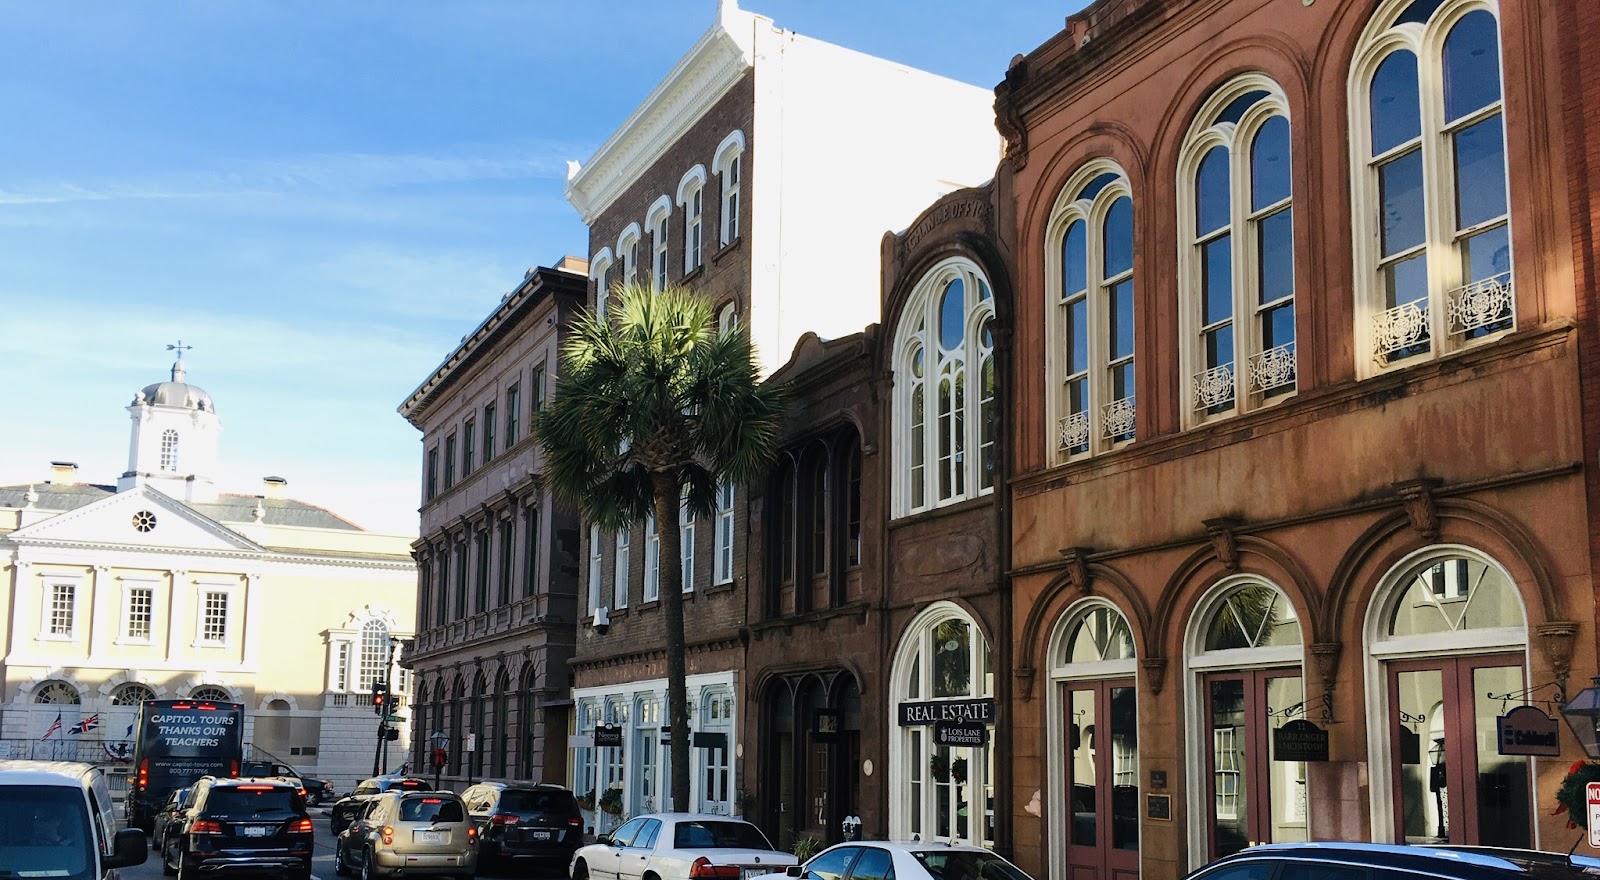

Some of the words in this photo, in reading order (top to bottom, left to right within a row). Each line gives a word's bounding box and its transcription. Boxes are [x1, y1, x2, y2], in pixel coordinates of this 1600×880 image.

[907, 706, 936, 722] REAL
[941, 703, 989, 719] ESTATE
[151, 714, 197, 724] CAPITOL
[199, 715, 235, 726] TOURS
[957, 716, 963, 725] 9
[158, 726, 202, 736] THANKS
[203, 726, 226, 736] OUR
[948, 728, 963, 736] LOIS
[964, 728, 981, 737] LANE
[165, 737, 219, 747] TEACHERS
[948, 735, 981, 744] PROPERTIES
